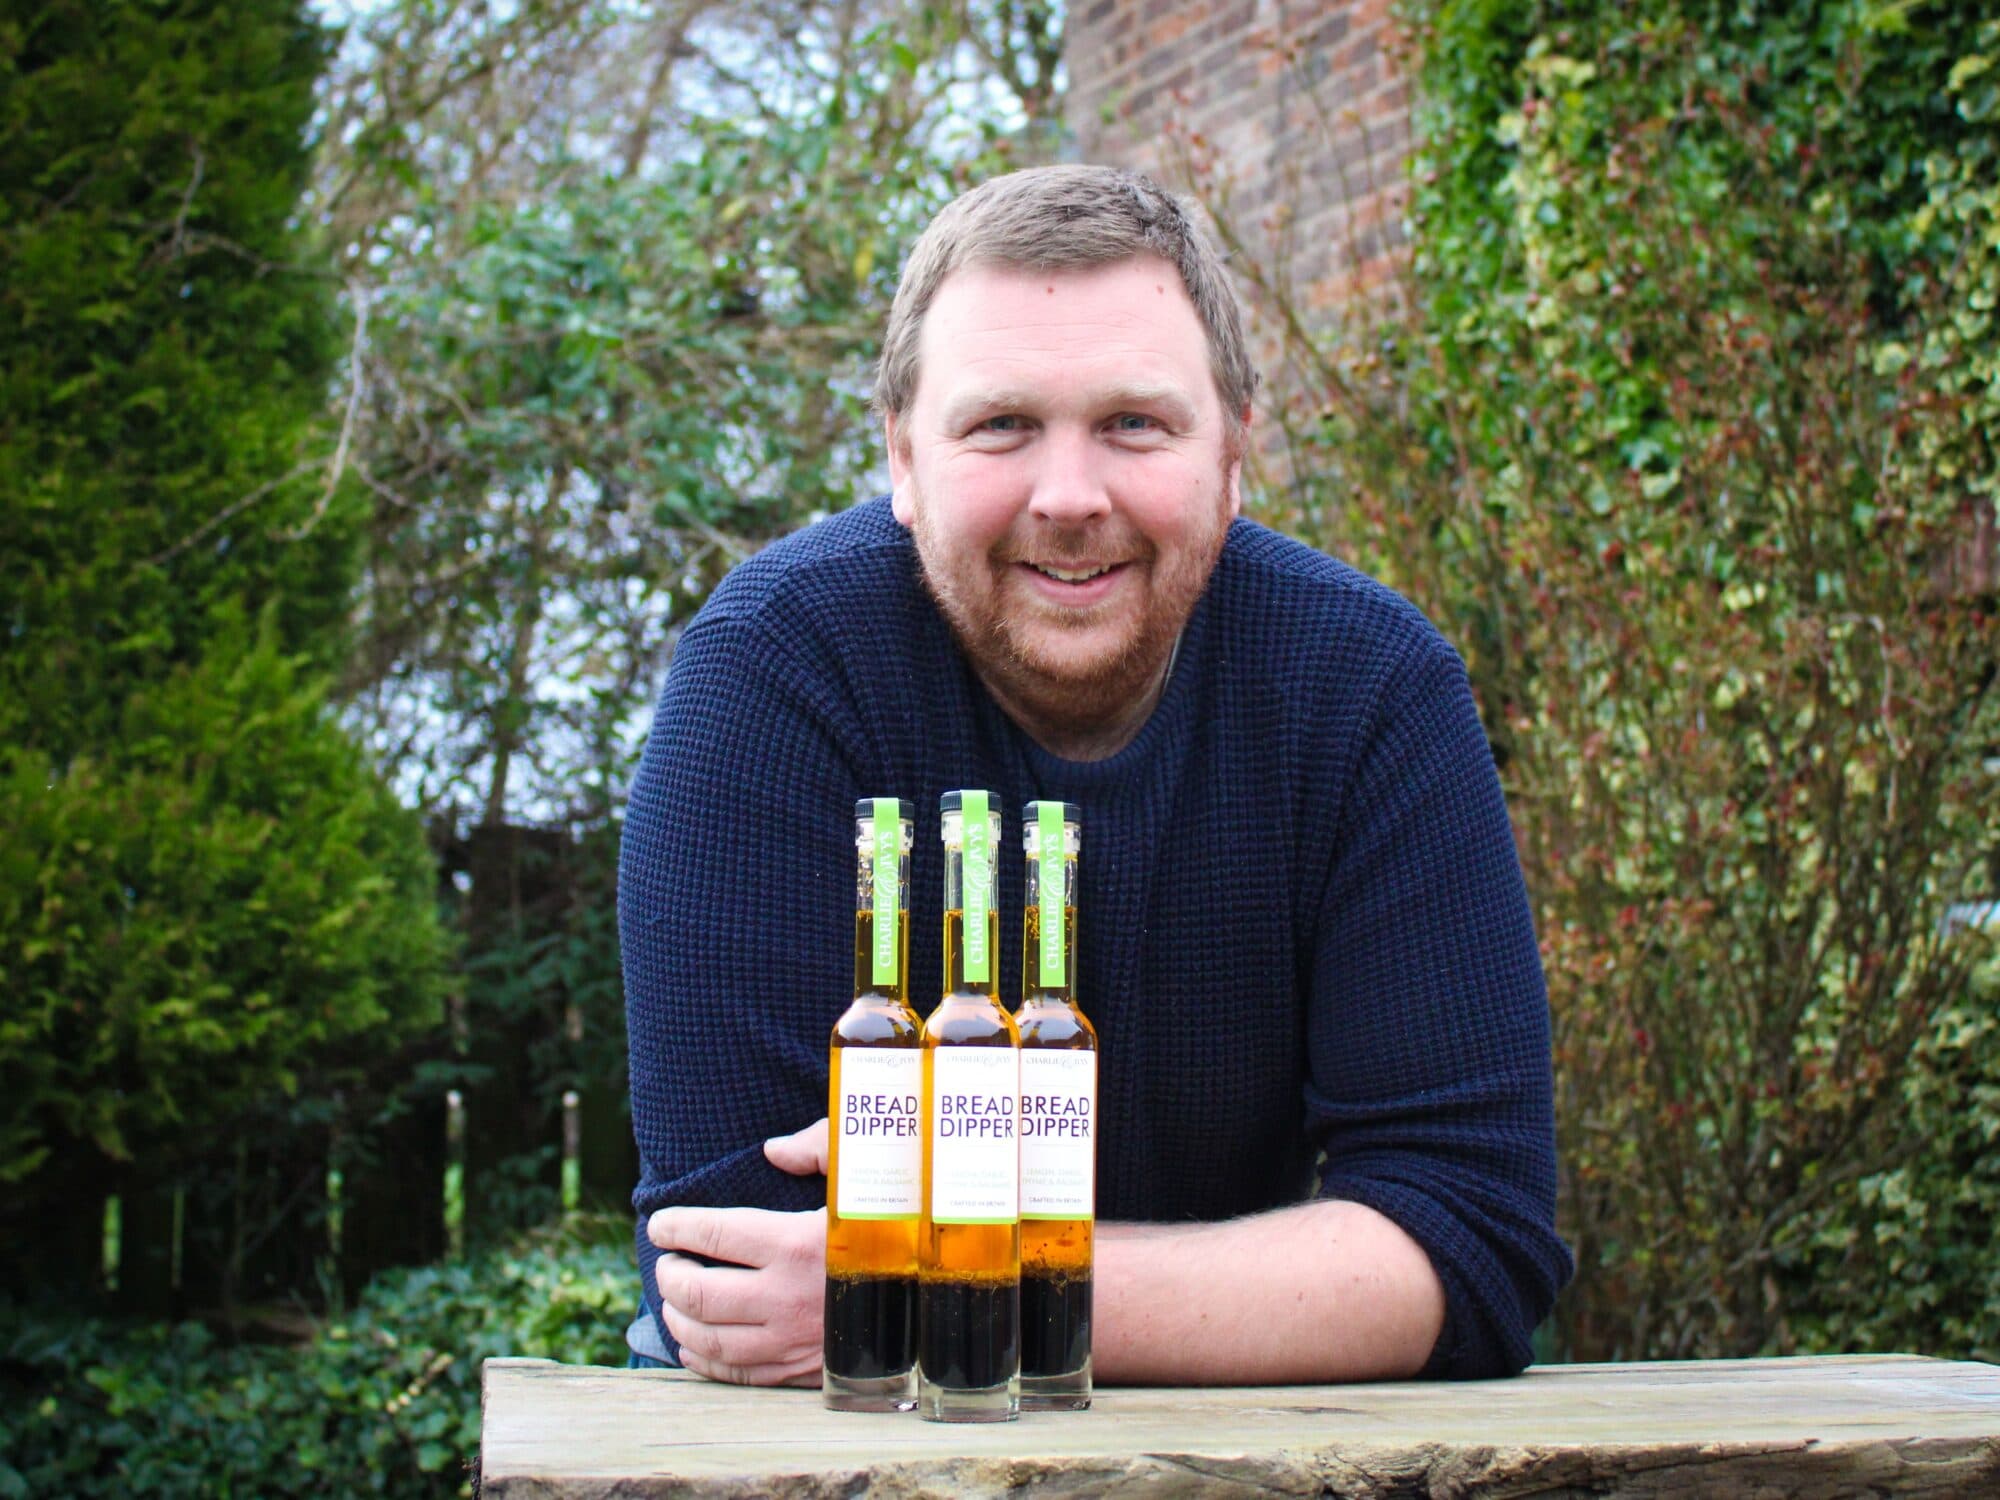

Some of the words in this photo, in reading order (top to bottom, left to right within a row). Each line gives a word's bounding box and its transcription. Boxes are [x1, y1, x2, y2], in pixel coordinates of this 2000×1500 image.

[879, 896, 892, 967] CHARLIE
[969, 891, 983, 963] CHARLIE
[1046, 900, 1058, 968] CHARLIE
[847, 1095, 918, 1115] BREAD
[942, 1095, 1014, 1116] BREAD
[1021, 1095, 1090, 1116] BREAD
[845, 1116, 917, 1137] DIPPER
[940, 1117, 1014, 1138] DIPPER
[1021, 1117, 1090, 1137] DIPPER
